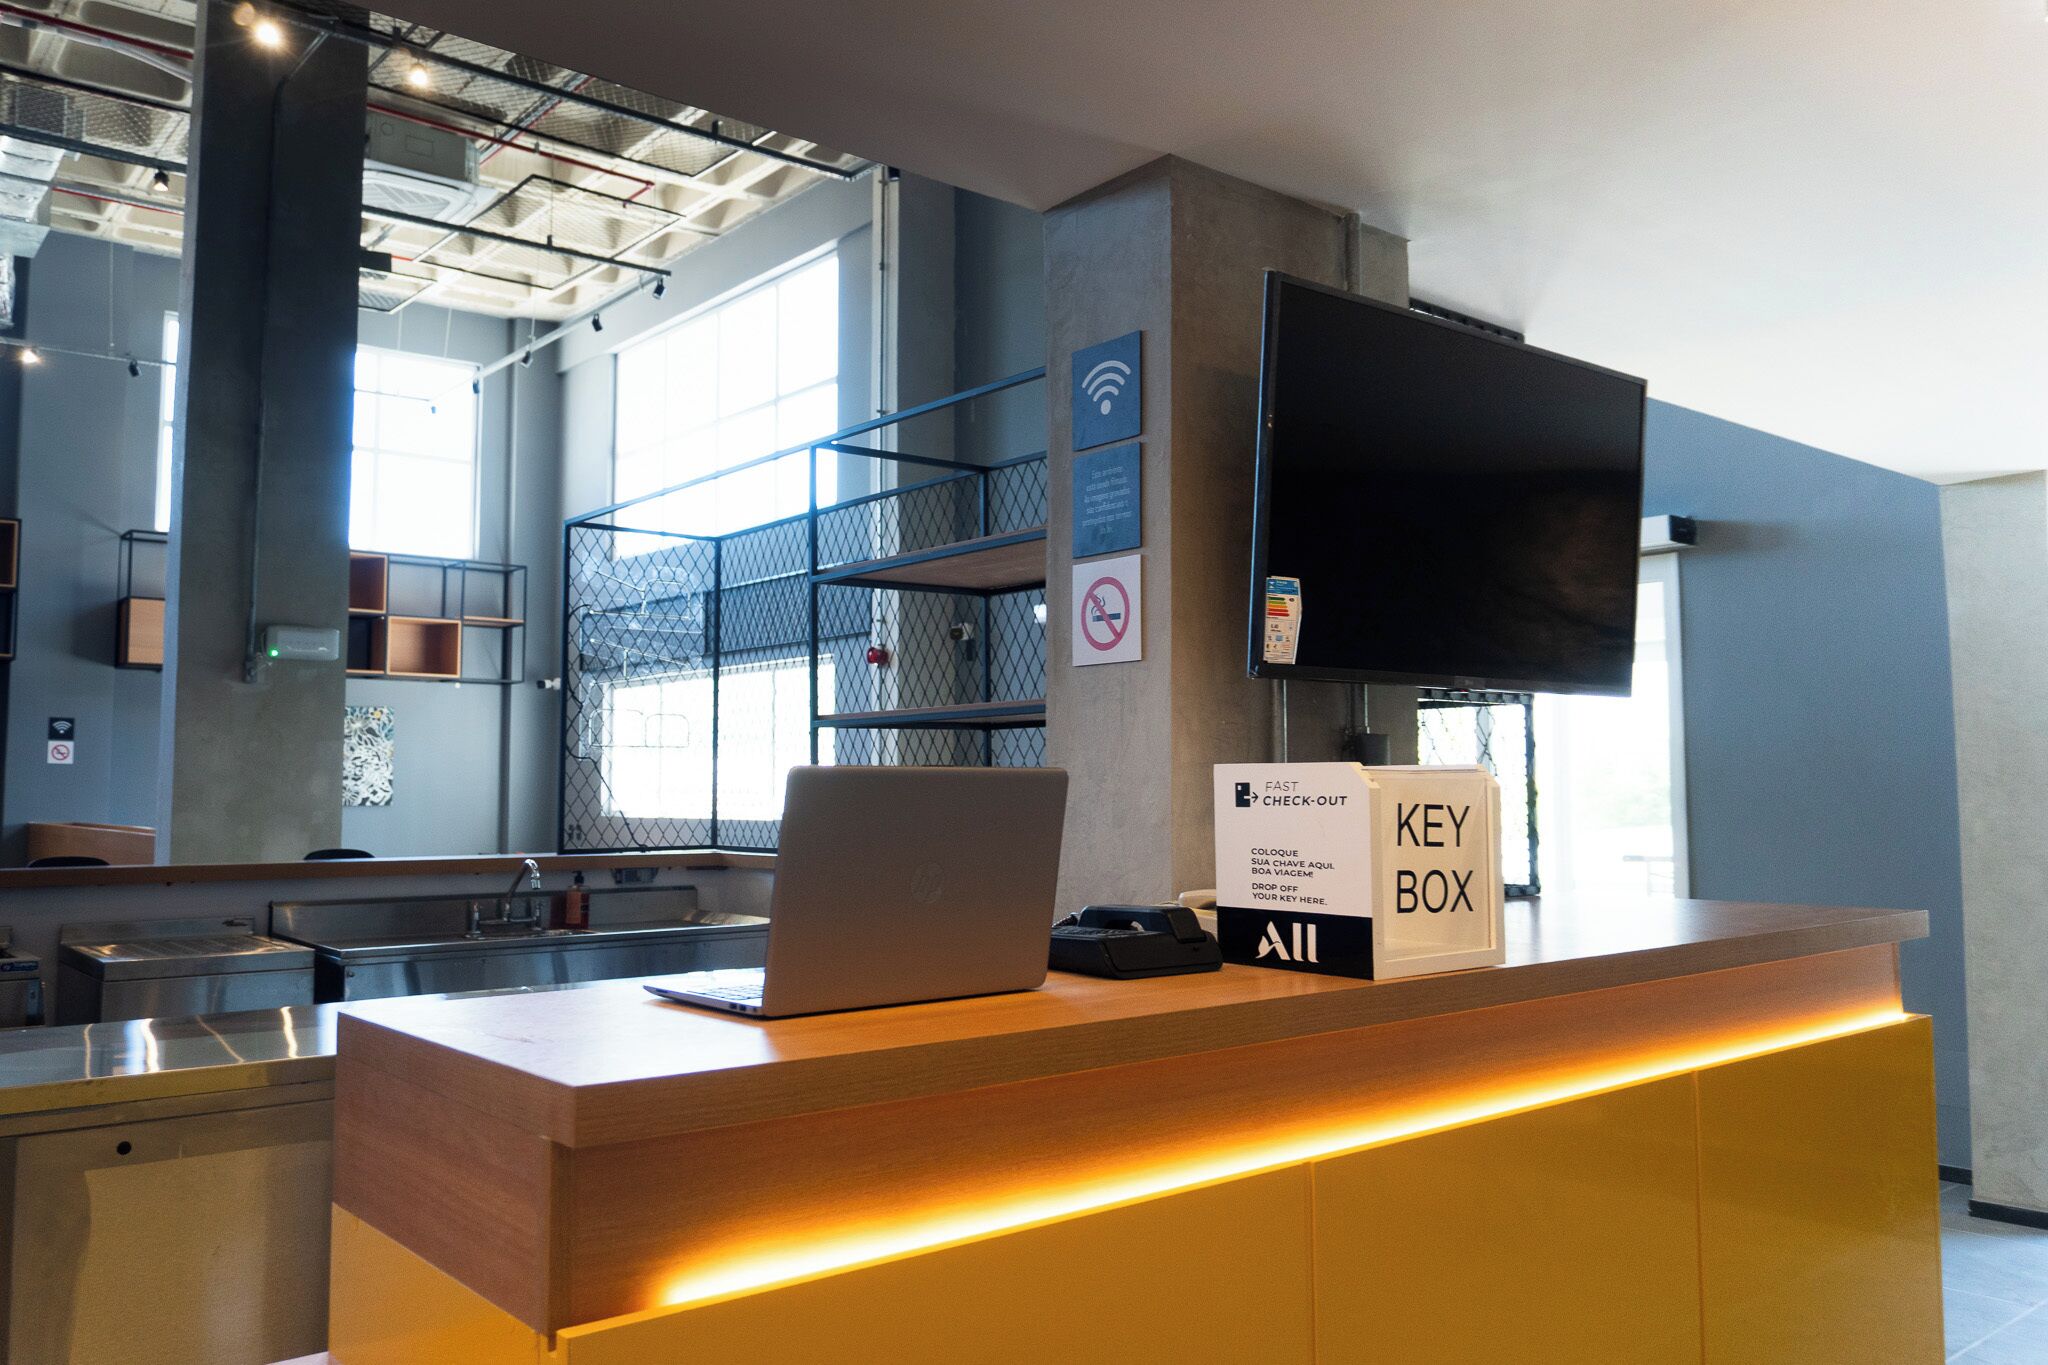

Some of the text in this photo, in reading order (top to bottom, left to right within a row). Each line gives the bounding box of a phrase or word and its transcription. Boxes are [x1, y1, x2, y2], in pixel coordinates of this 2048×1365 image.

[1265, 780, 1299, 792] FAST
[1263, 795, 1348, 807] CHECK-OUT
[1397, 803, 1470, 847] KEY
[1251, 848, 1299, 857] COLOQUE
[1251, 857, 1270, 866] SUA
[1272, 860, 1306, 868] CHAVE
[1251, 867, 1314, 878] BOA VIAGEM!
[1252, 883, 1299, 893] DROP OFF
[1396, 869, 1474, 913] BOX
[1252, 892, 1328, 906] YOUR KEY HERE.
